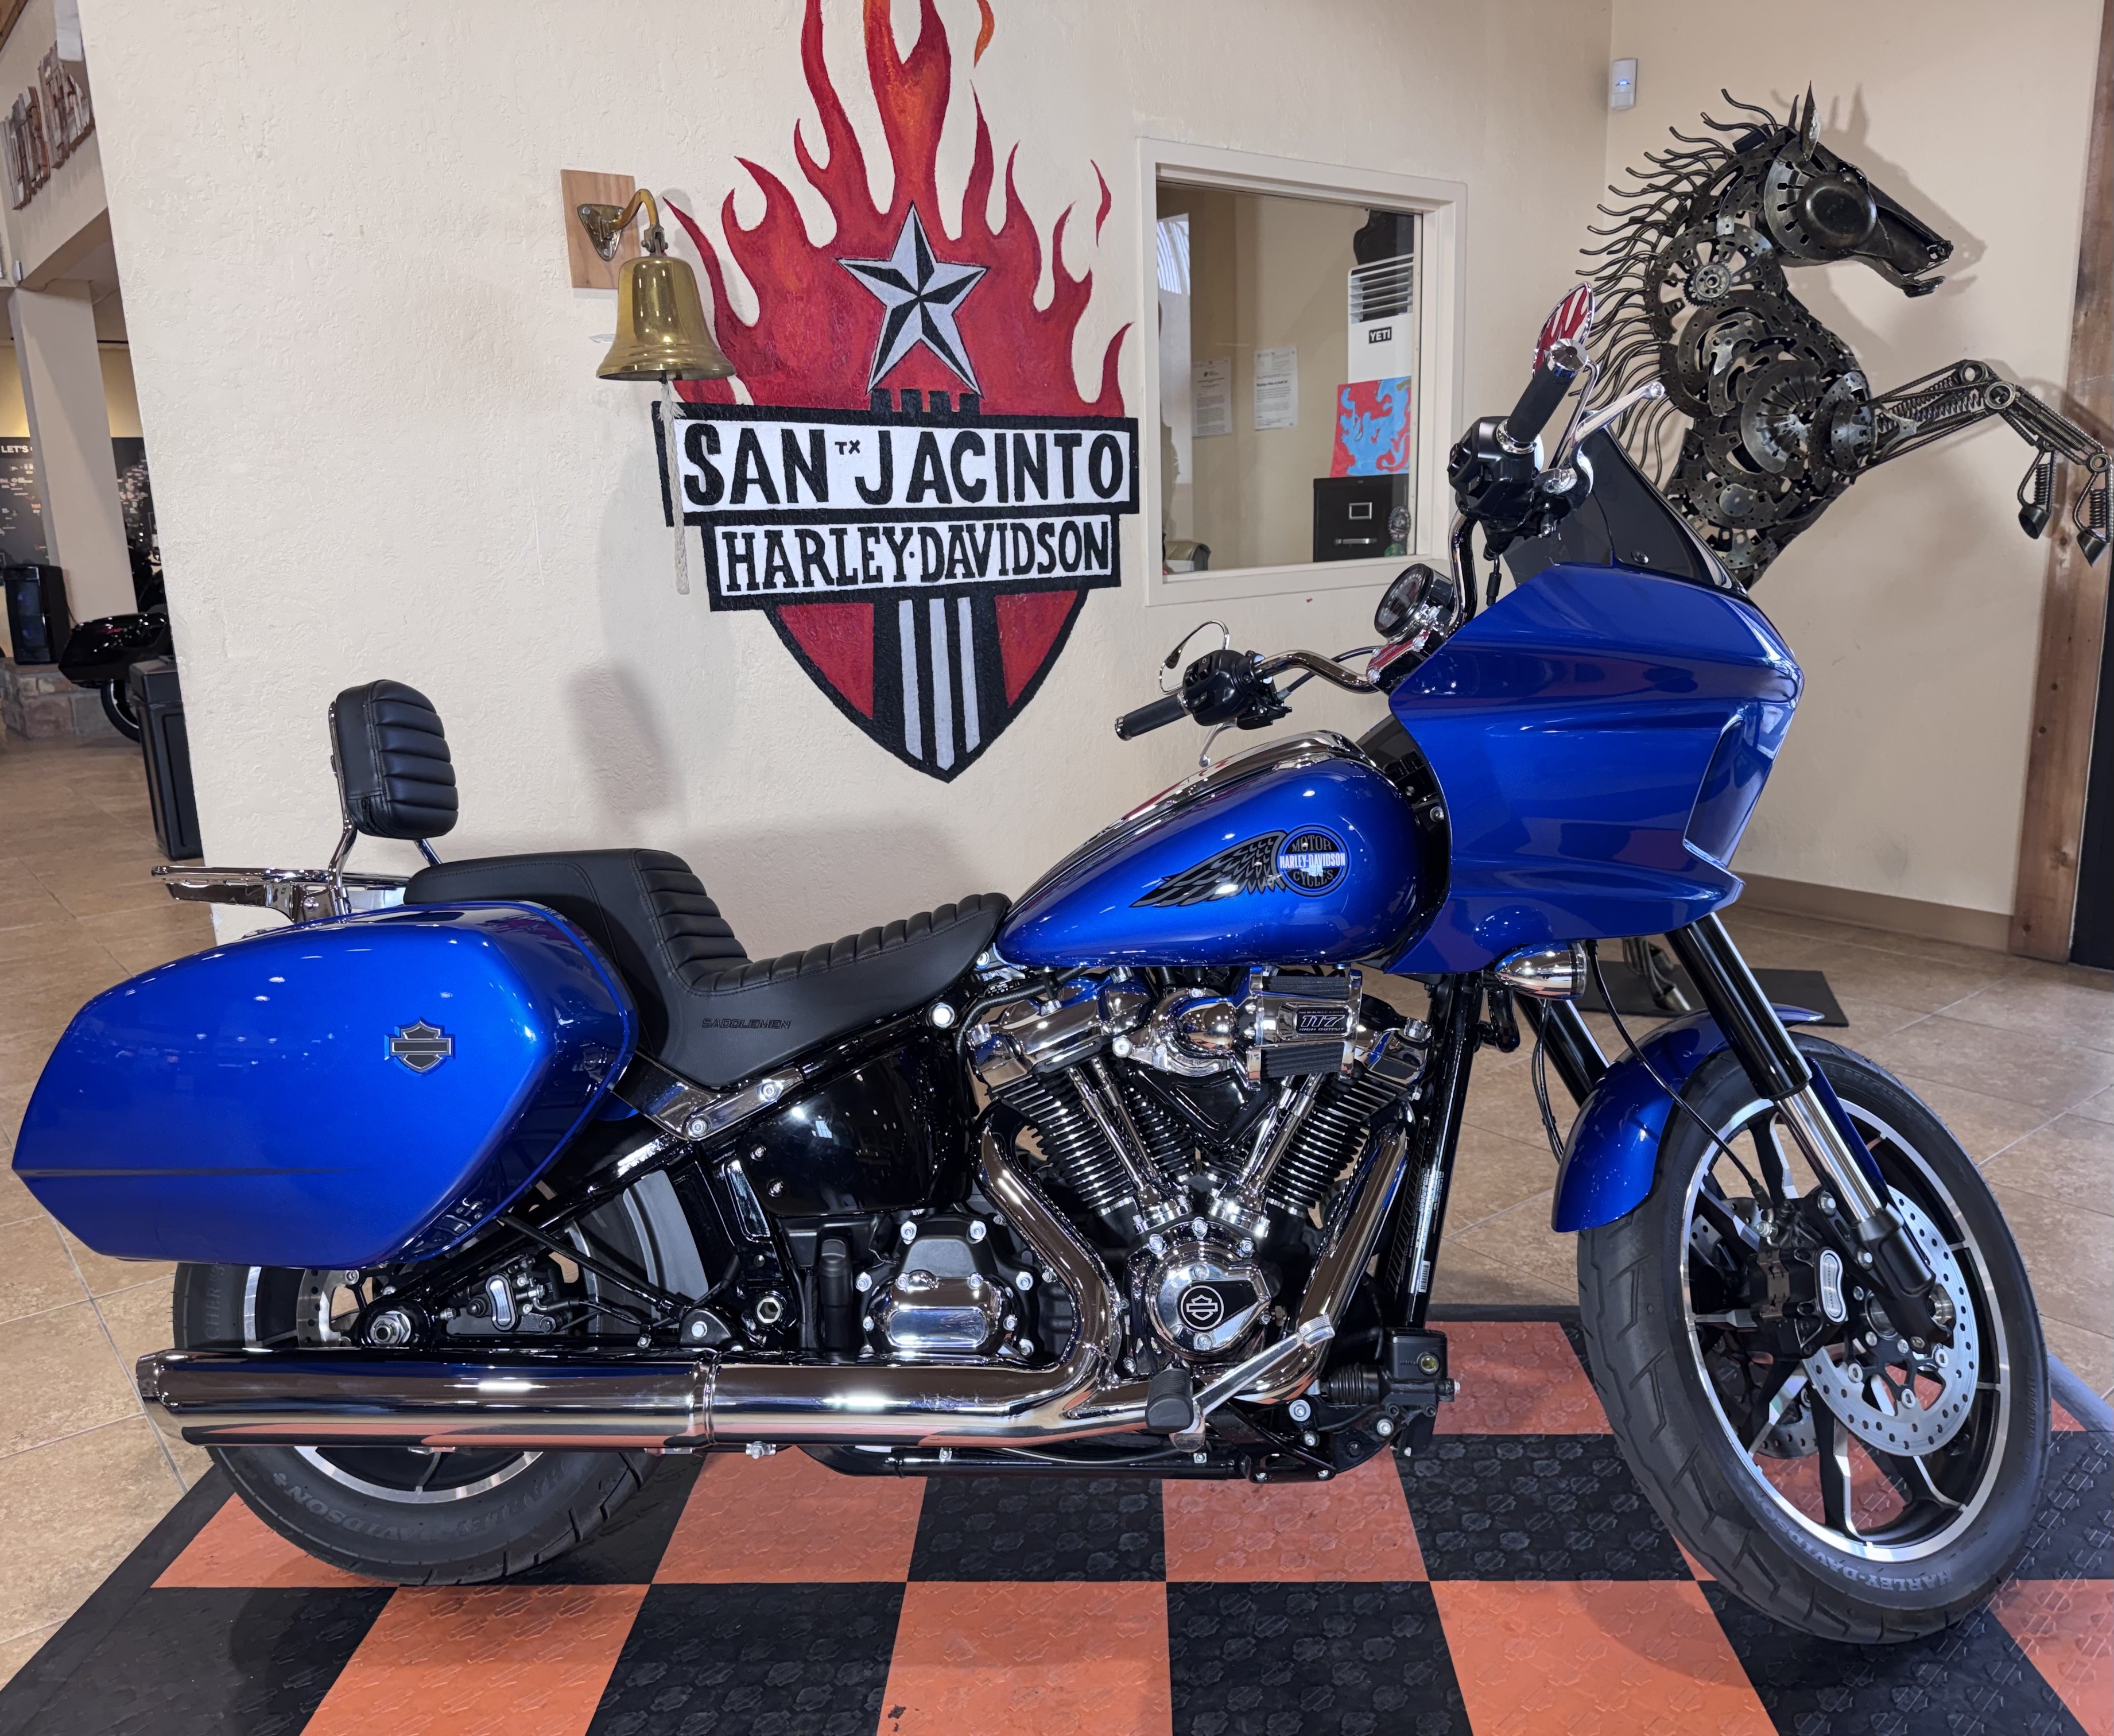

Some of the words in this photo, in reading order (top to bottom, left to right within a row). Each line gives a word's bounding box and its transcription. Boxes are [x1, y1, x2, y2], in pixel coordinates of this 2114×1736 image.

[1370, 329, 1390, 342] YETI
[1, 445, 29, 453] LET'S
[683, 423, 830, 507] SAN
[855, 430, 1124, 505] JACINTO
[1291, 835, 1332, 852] MOTOR
[1279, 852, 1346, 869] HARLEY-DAVIDSON
[701, 1018, 792, 1029] SADDLEMEN
[1300, 1014, 1345, 1028] 117
[1747, 1484, 1954, 1592] HARLEY-DAVIDSON
